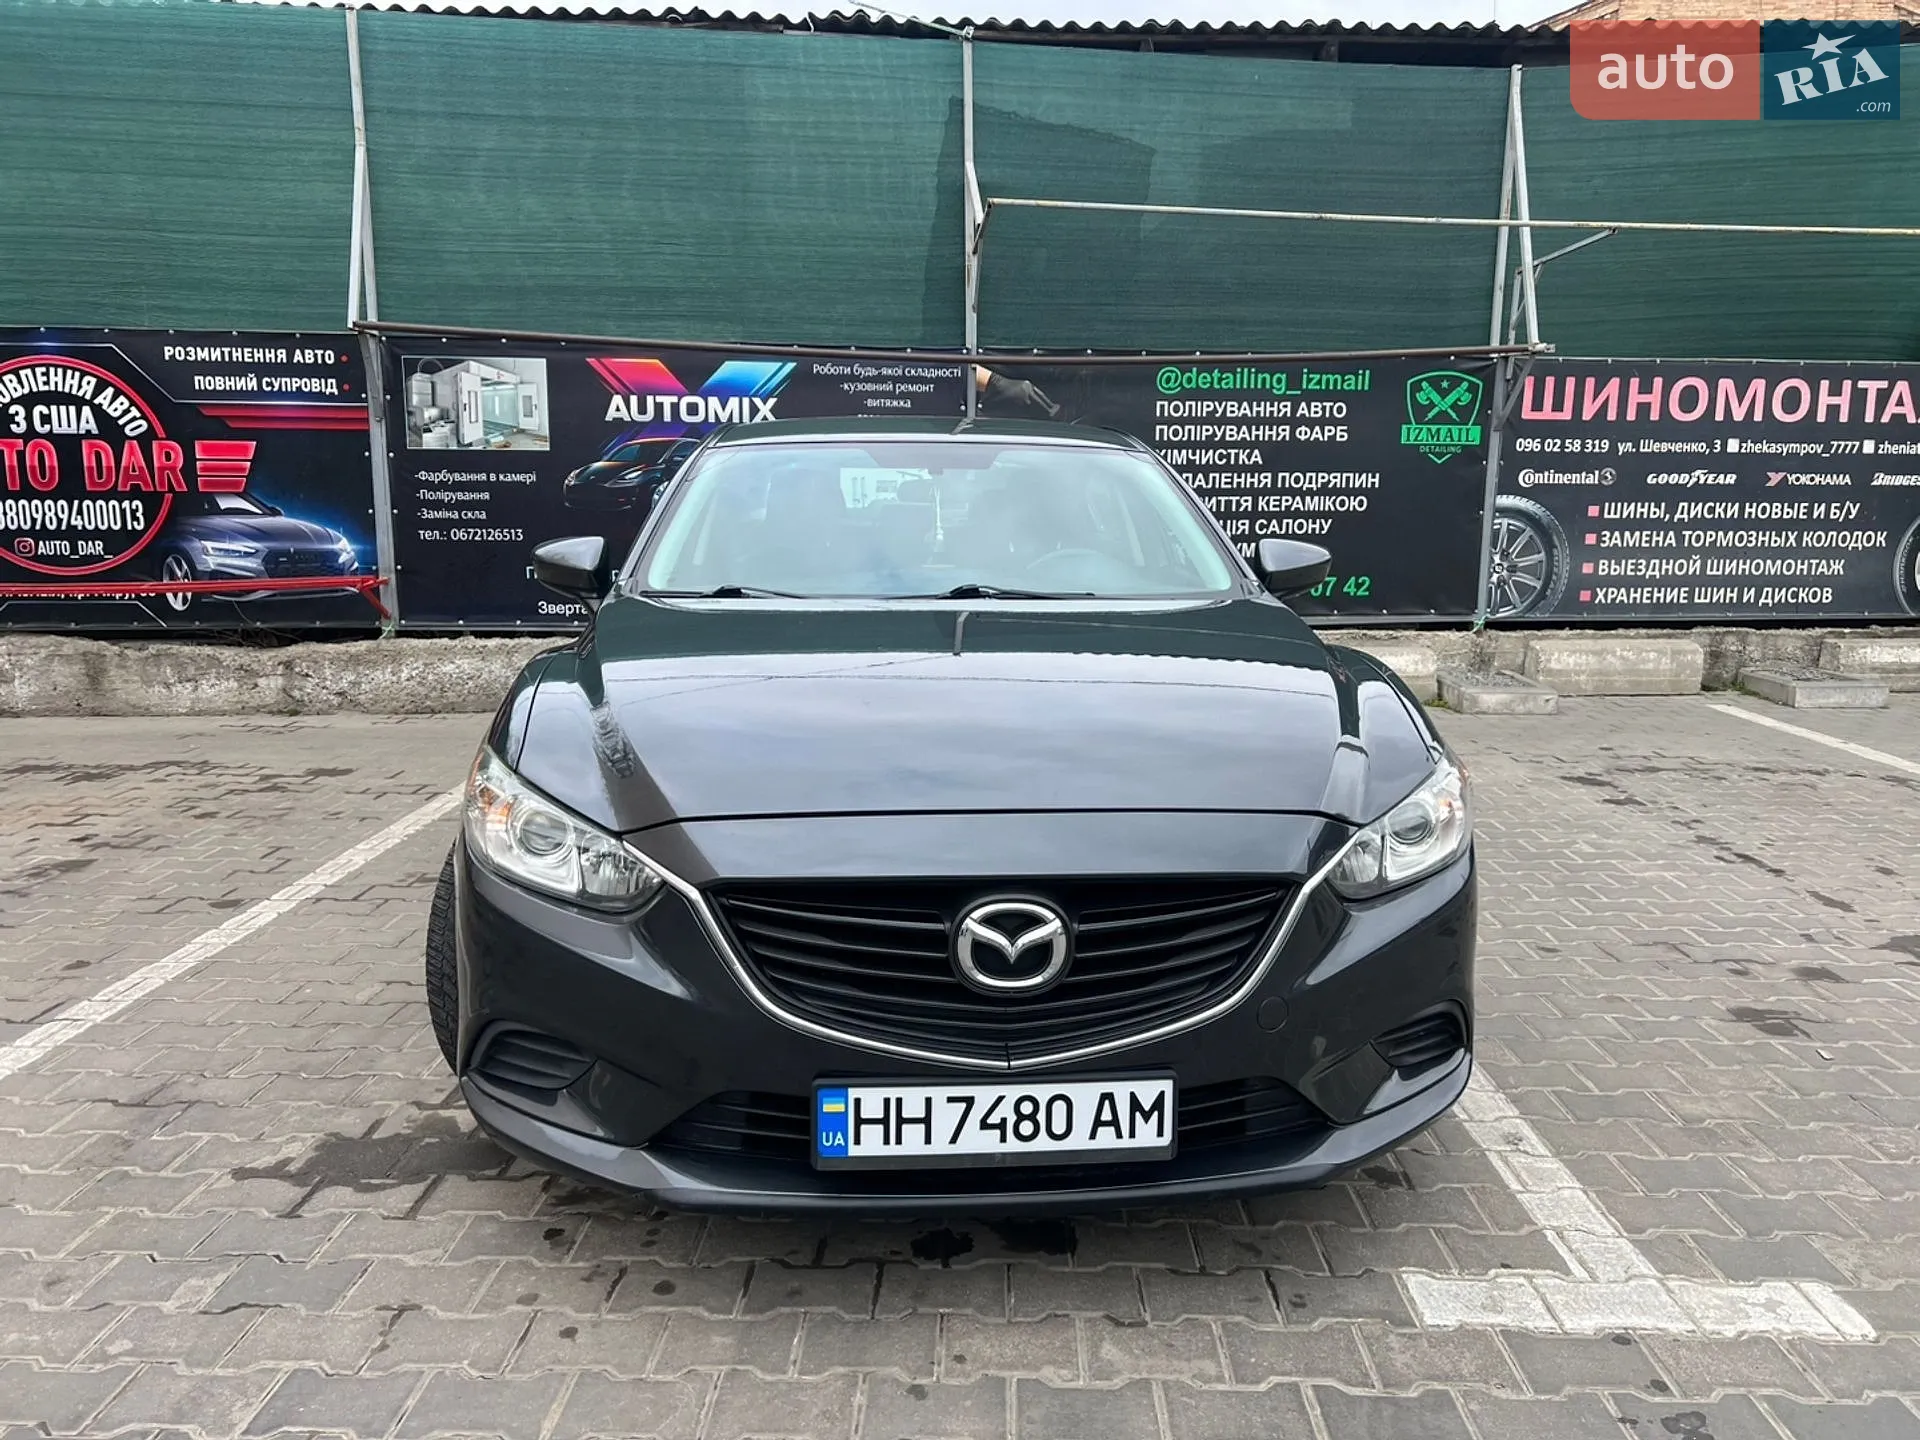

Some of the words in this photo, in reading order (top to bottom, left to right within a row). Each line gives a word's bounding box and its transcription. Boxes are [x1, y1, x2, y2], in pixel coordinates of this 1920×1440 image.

[163, 346, 288, 364] РОЗМИТНЕННЯ
[293, 349, 335, 365] АВТО
[812, 363, 850, 375] Роботи
[904, 366, 962, 378] складності
[194, 373, 259, 392] ПОВНИЙ
[262, 377, 339, 396] СУПРОВІД
[895, 383, 935, 395] ремонт
[1156, 366, 1372, 395] @detailing_izmail
[604, 394, 779, 424] AUTOMIX
[1520, 375, 1920, 424] ШИНОМОНТА
[93, 386, 149, 438] АВТО
[1155, 400, 1291, 418] ПОЛІРУВАННЯ
[1296, 401, 1348, 419] АВТО
[32, 404, 99, 435] США
[1154, 424, 1291, 442] ПОЛІРУВАННЯ
[1294, 425, 1349, 442] ФАРБ
[1406, 427, 1476, 443] IZMAIL
[1515, 438, 1542, 453] 096
[1544, 438, 1562, 453] 02
[1564, 439, 1582, 453] 58
[1584, 438, 1610, 453] 319
[1617, 440, 1637, 456] ул.
[1639, 438, 1710, 456] Шевченко,
[1713, 438, 1722, 454] 3
[81, 439, 188, 492] DAR
[414, 469, 487, 485] -Фарбування
[489, 472, 497, 482] в
[498, 470, 537, 485] камері
[1277, 472, 1380, 491] ПОДРЯПИН
[1518, 468, 1600, 488] Continental
[1646, 468, 1738, 488] GOODYEAR
[1786, 472, 1852, 486] YOKOHAMA
[415, 488, 491, 503] -Полірування
[1258, 495, 1369, 513] КЕРАМІКОЮ
[417, 508, 460, 520] -Заміна
[461, 509, 487, 520] скла
[1603, 501, 1671, 522] ШИНЫ,
[1674, 502, 1740, 522] ДИСКИ
[1743, 502, 1809, 520] НОВЫЕ
[1812, 503, 1826, 520] И
[1828, 500, 1861, 523] Б/У
[417, 529, 447, 541] тел.:
[450, 527, 524, 541] 0672126513
[1255, 518, 1333, 536] САЛОНУ
[38, 540, 114, 559] AUTO_DAR_
[1599, 530, 1677, 548] ЗАМЕНА
[1682, 530, 1798, 548] ТОРМОЗНЫХ
[1802, 530, 1888, 551] КОЛОДОК
[1597, 554, 1702, 579] ВЫЕЗДНОЙ
[1706, 558, 1846, 577] ШИНОМОНТАЖ
[1342, 576, 1371, 596] 42
[1593, 586, 1689, 605] ХРАНЕНИЕ
[1693, 586, 1738, 605] ШИН
[1742, 586, 1755, 605] И
[1758, 586, 1834, 607] ДИСКОВ
[852, 1095, 933, 1146] HH
[946, 1092, 1074, 1144] 7480
[1088, 1089, 1166, 1141] AM
[822, 1131, 845, 1147] UA
